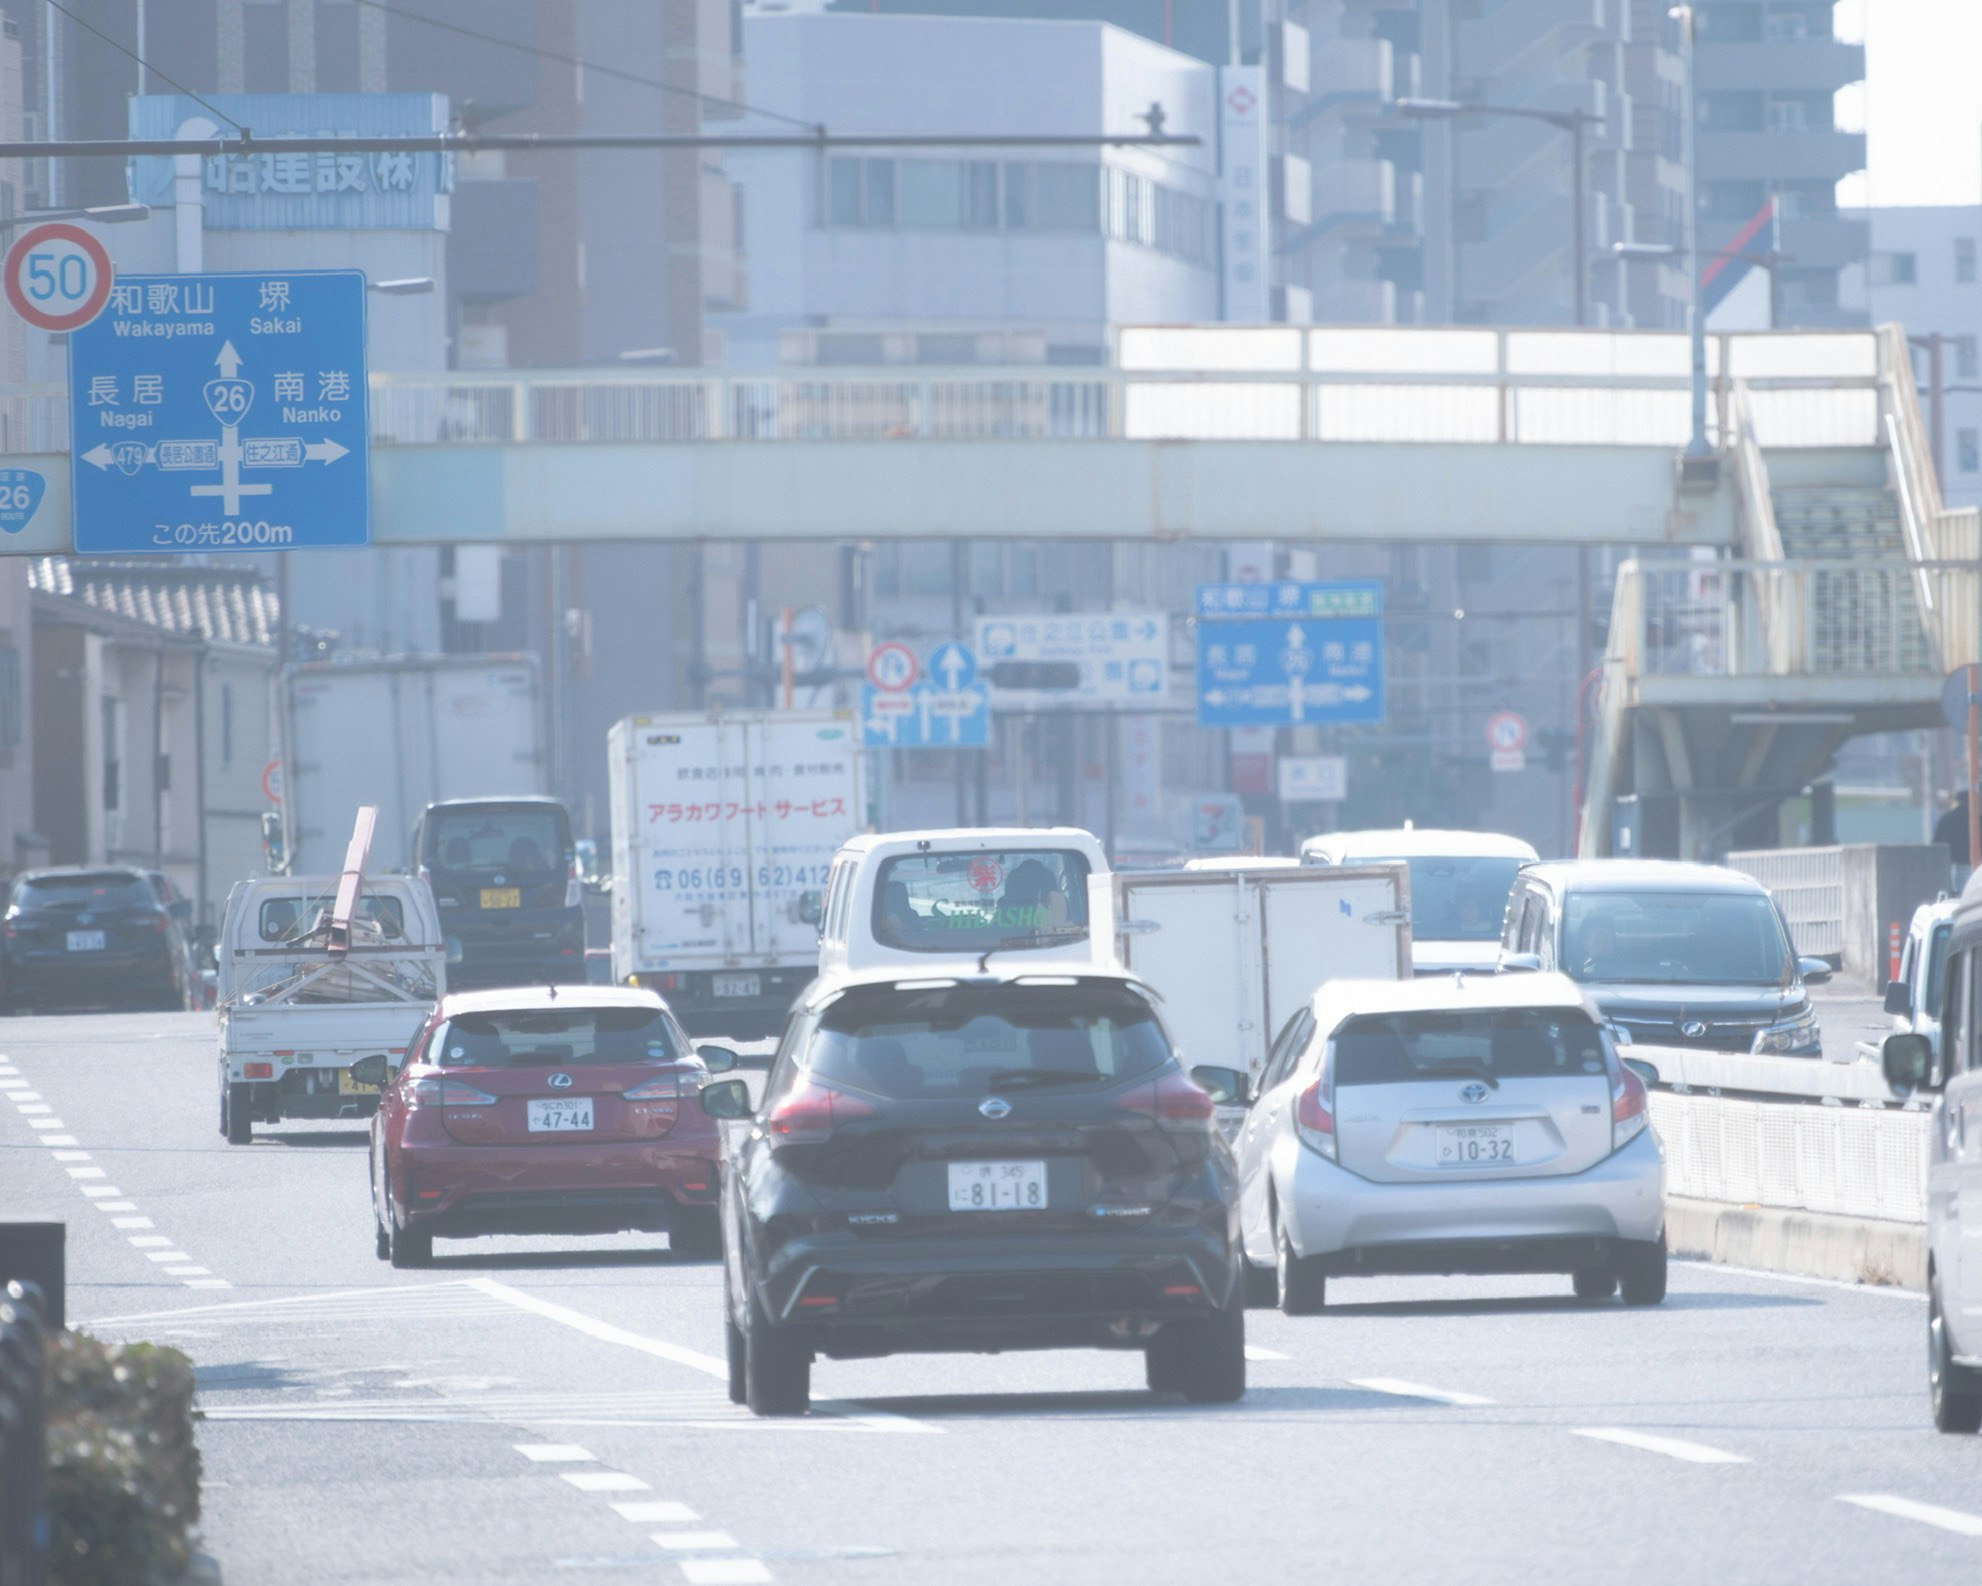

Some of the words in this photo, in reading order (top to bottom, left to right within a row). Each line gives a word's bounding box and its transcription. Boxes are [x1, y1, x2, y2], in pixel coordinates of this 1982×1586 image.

[28, 254, 87, 300] 50
[111, 283, 214, 316] 和歌山
[259, 281, 291, 312] 堺
[113, 320, 215, 339] Wakayama
[250, 317, 301, 335] Sakai
[87, 374, 164, 406] 長居
[273, 371, 350, 403] 南港
[214, 386, 244, 413] 26
[101, 411, 153, 430] Nagai
[282, 407, 341, 423] Nanko
[117, 446, 145, 465] 479
[247, 443, 299, 462] 住之江通
[0, 485, 30, 509] 26
[542, 1111, 590, 1129] 47-44
[1458, 1140, 1512, 1161] 10-32
[971, 1182, 1039, 1206] 81-18
